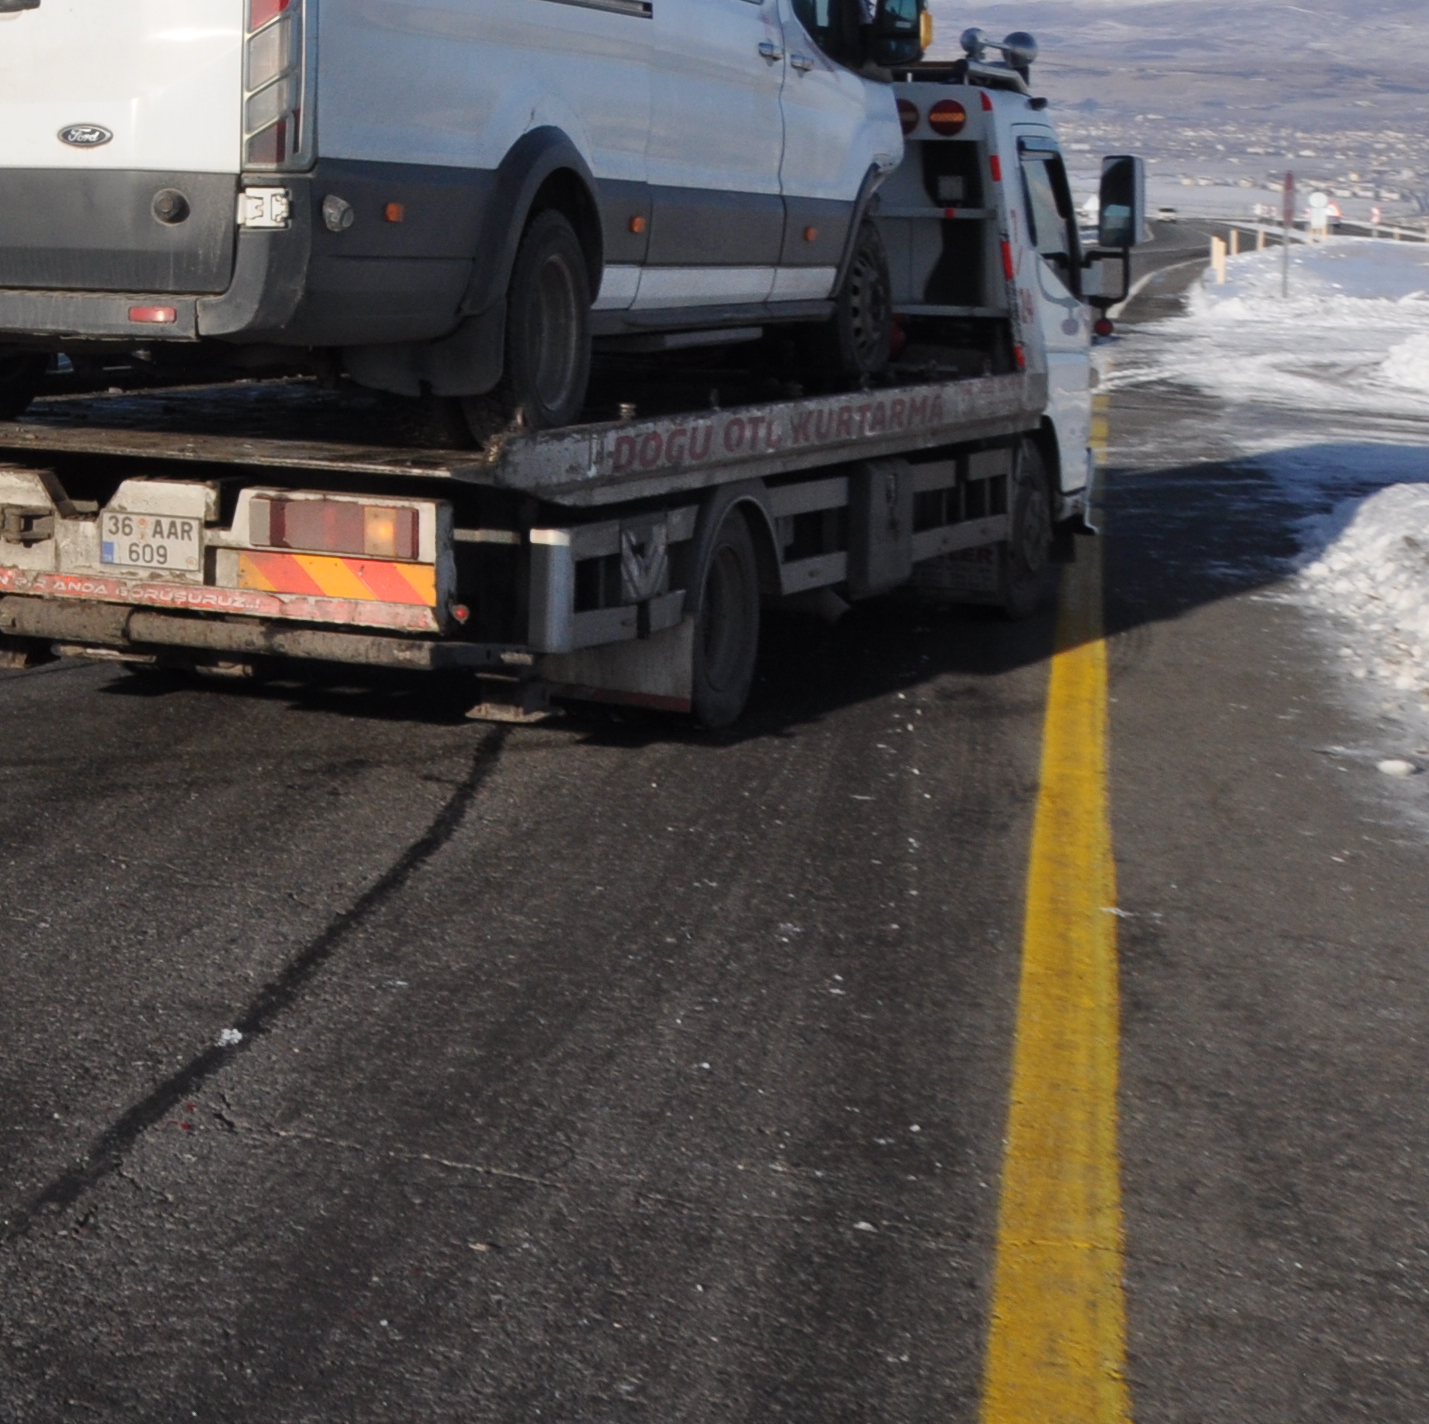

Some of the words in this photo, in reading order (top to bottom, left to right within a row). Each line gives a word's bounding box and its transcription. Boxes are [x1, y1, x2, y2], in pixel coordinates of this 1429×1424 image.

[107, 515, 134, 537] 36
[151, 518, 194, 542] AAR
[128, 542, 169, 565] 609
[52, 581, 109, 595] ANDA
